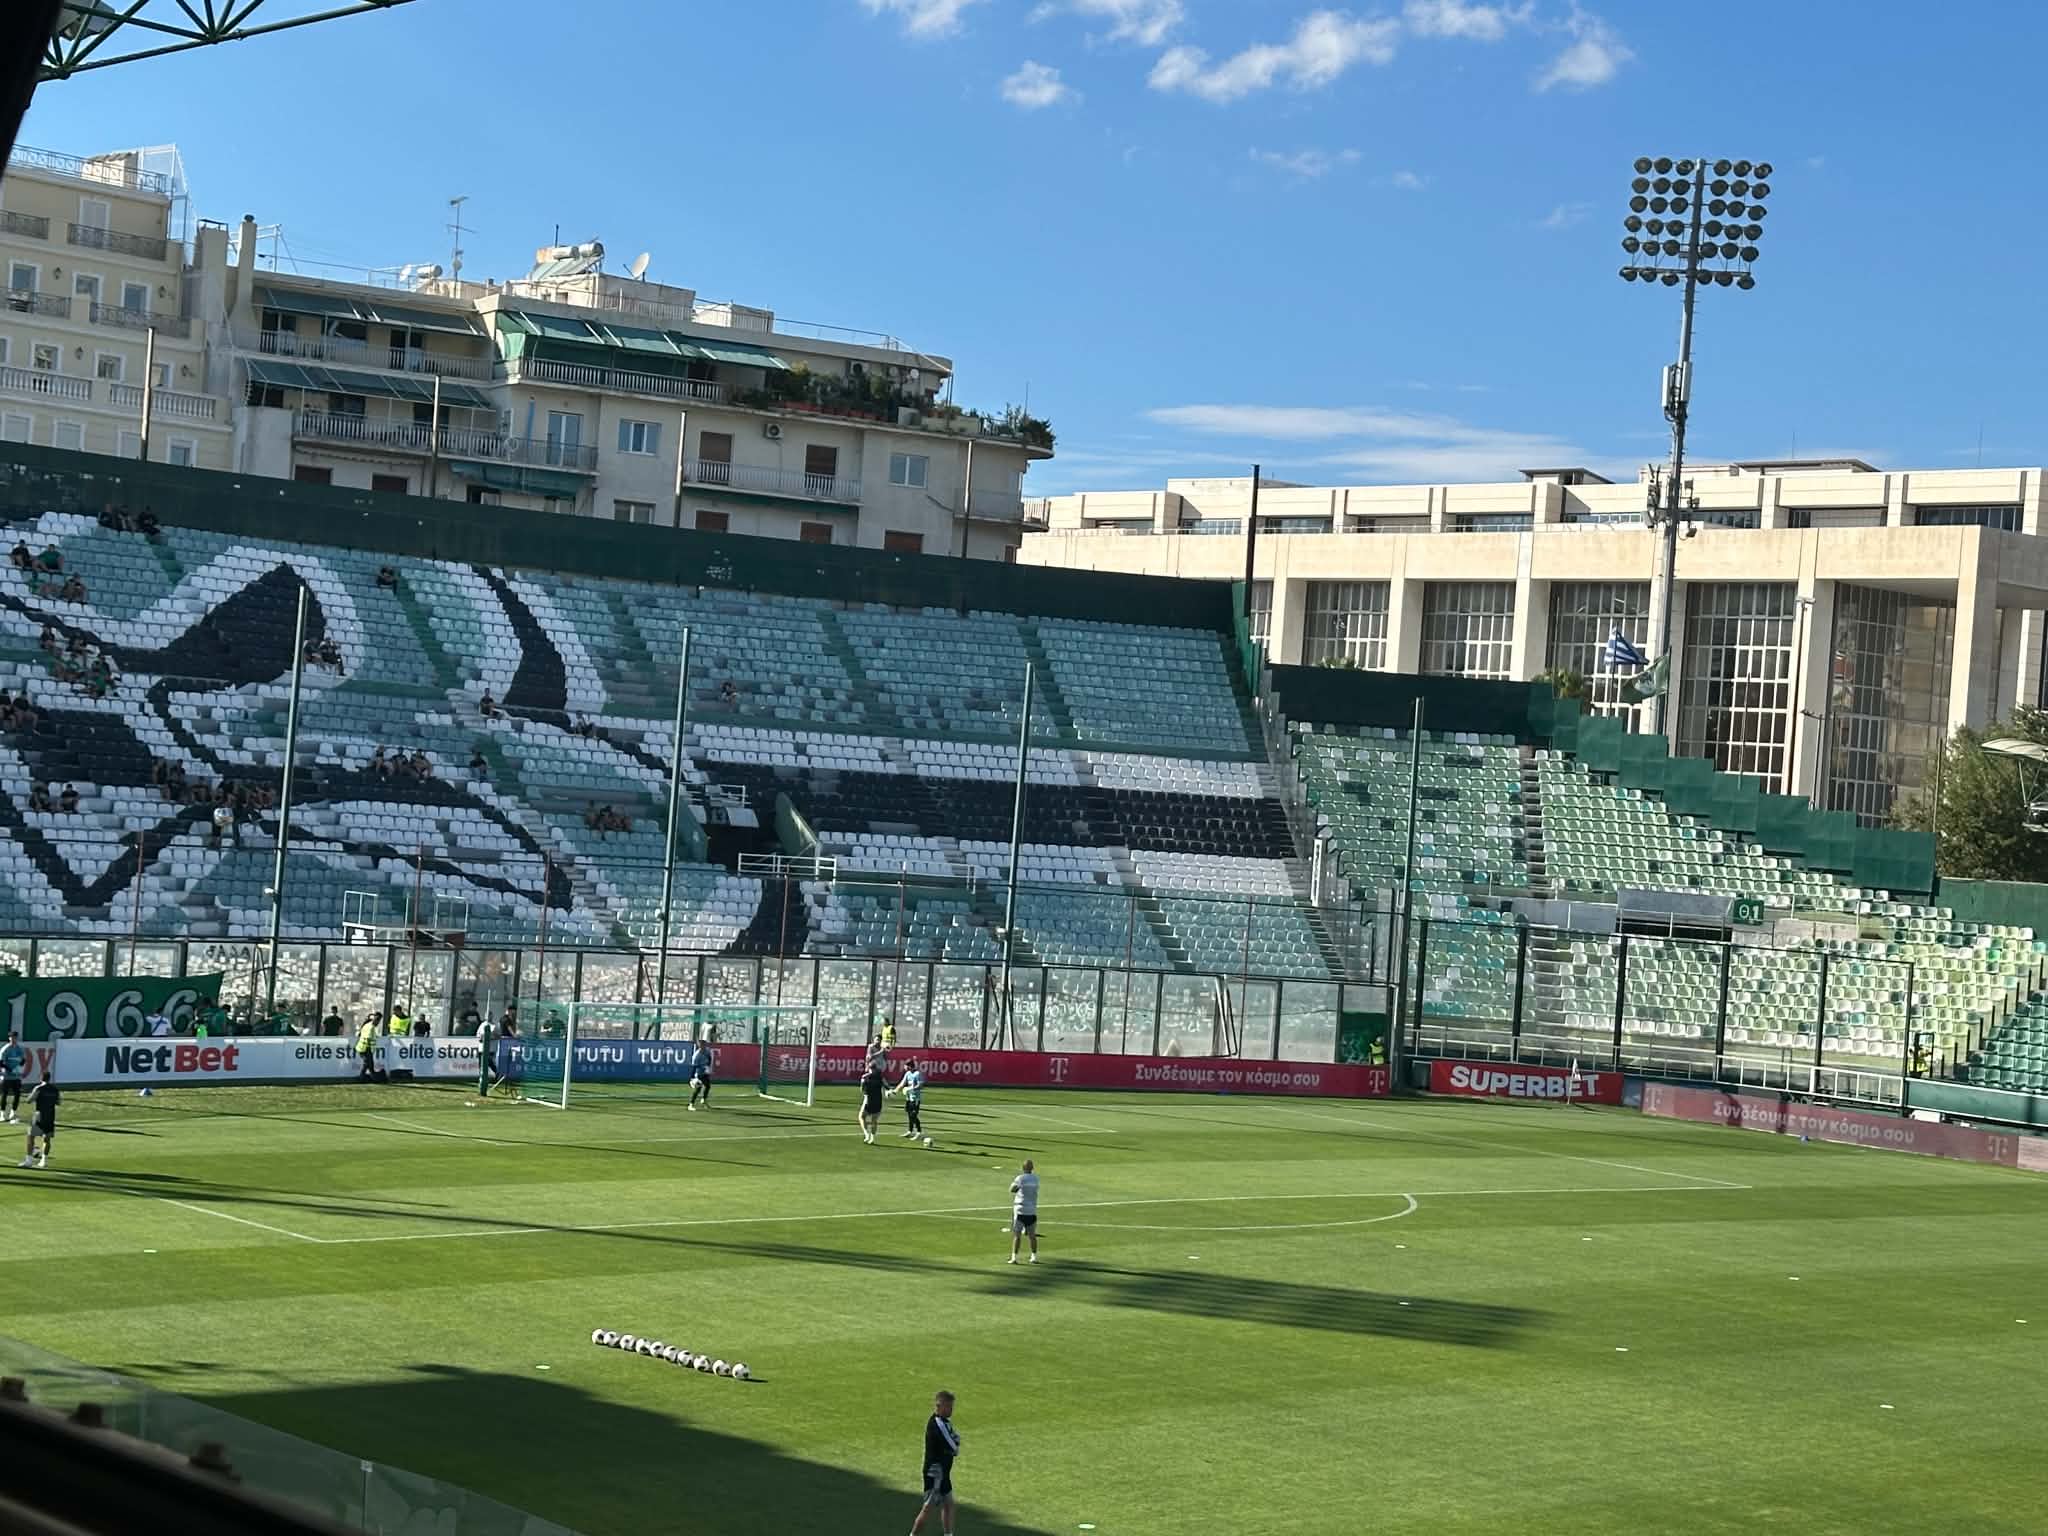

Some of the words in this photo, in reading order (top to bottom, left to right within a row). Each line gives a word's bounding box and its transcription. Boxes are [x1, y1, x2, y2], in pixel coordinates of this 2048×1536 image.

[8, 988, 199, 1041] 1966
[104, 1045, 239, 1074] NetBet
[295, 1044, 332, 1059] elite
[400, 1043, 433, 1059] elite
[511, 1046, 559, 1062] TUTU
[574, 1046, 624, 1063] TUTU
[638, 1046, 686, 1064] TUTU
[780, 1053, 865, 1075] Συνέουμε
[952, 1061, 982, 1075] σου
[1136, 1064, 1215, 1085] Συνδέουμε
[1217, 1070, 1243, 1083] τον
[1246, 1066, 1291, 1087] κόσμο
[1293, 1073, 1320, 1086] σου
[1450, 1065, 1600, 1097] SUPERBET
[1713, 1100, 1797, 1128] Συνδέουμε
[1829, 1118, 1880, 1139] κόσμο
